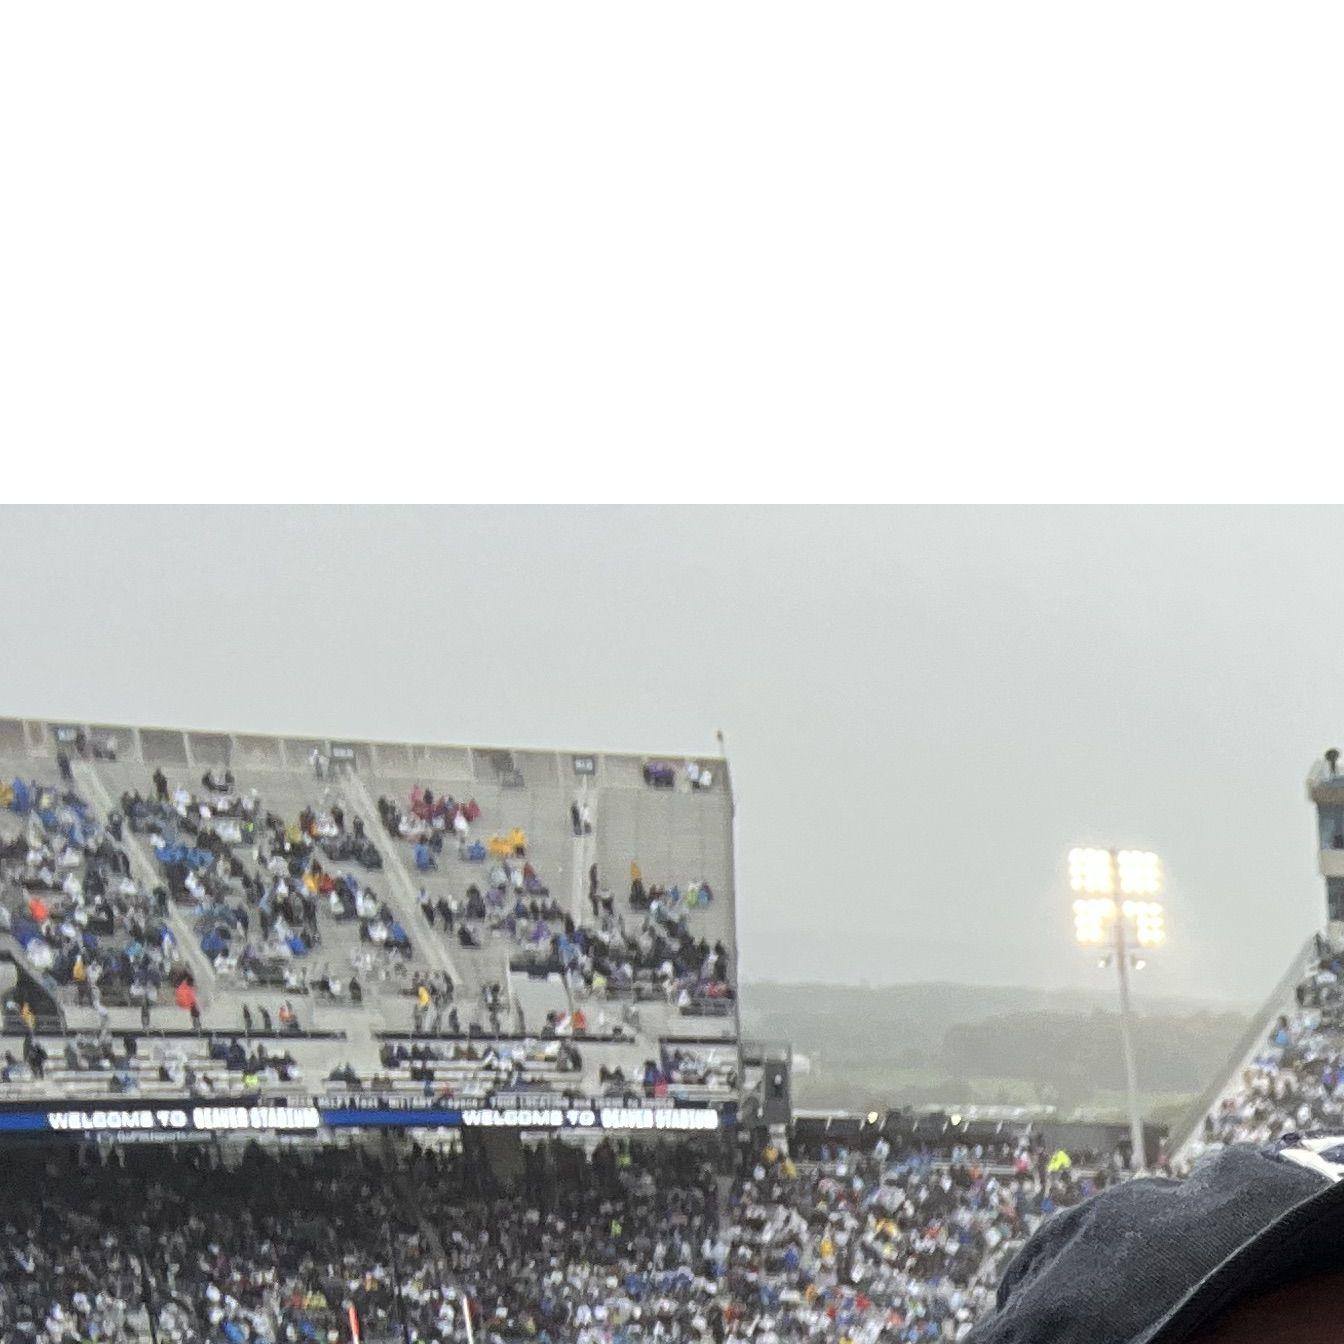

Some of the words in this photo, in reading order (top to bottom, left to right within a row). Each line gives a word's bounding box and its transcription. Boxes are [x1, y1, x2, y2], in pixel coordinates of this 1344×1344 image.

[48, 1110, 153, 1130] WELCOME
[156, 1109, 188, 1128] TO
[462, 1109, 563, 1127] WELCOME
[566, 1109, 595, 1126] TO
